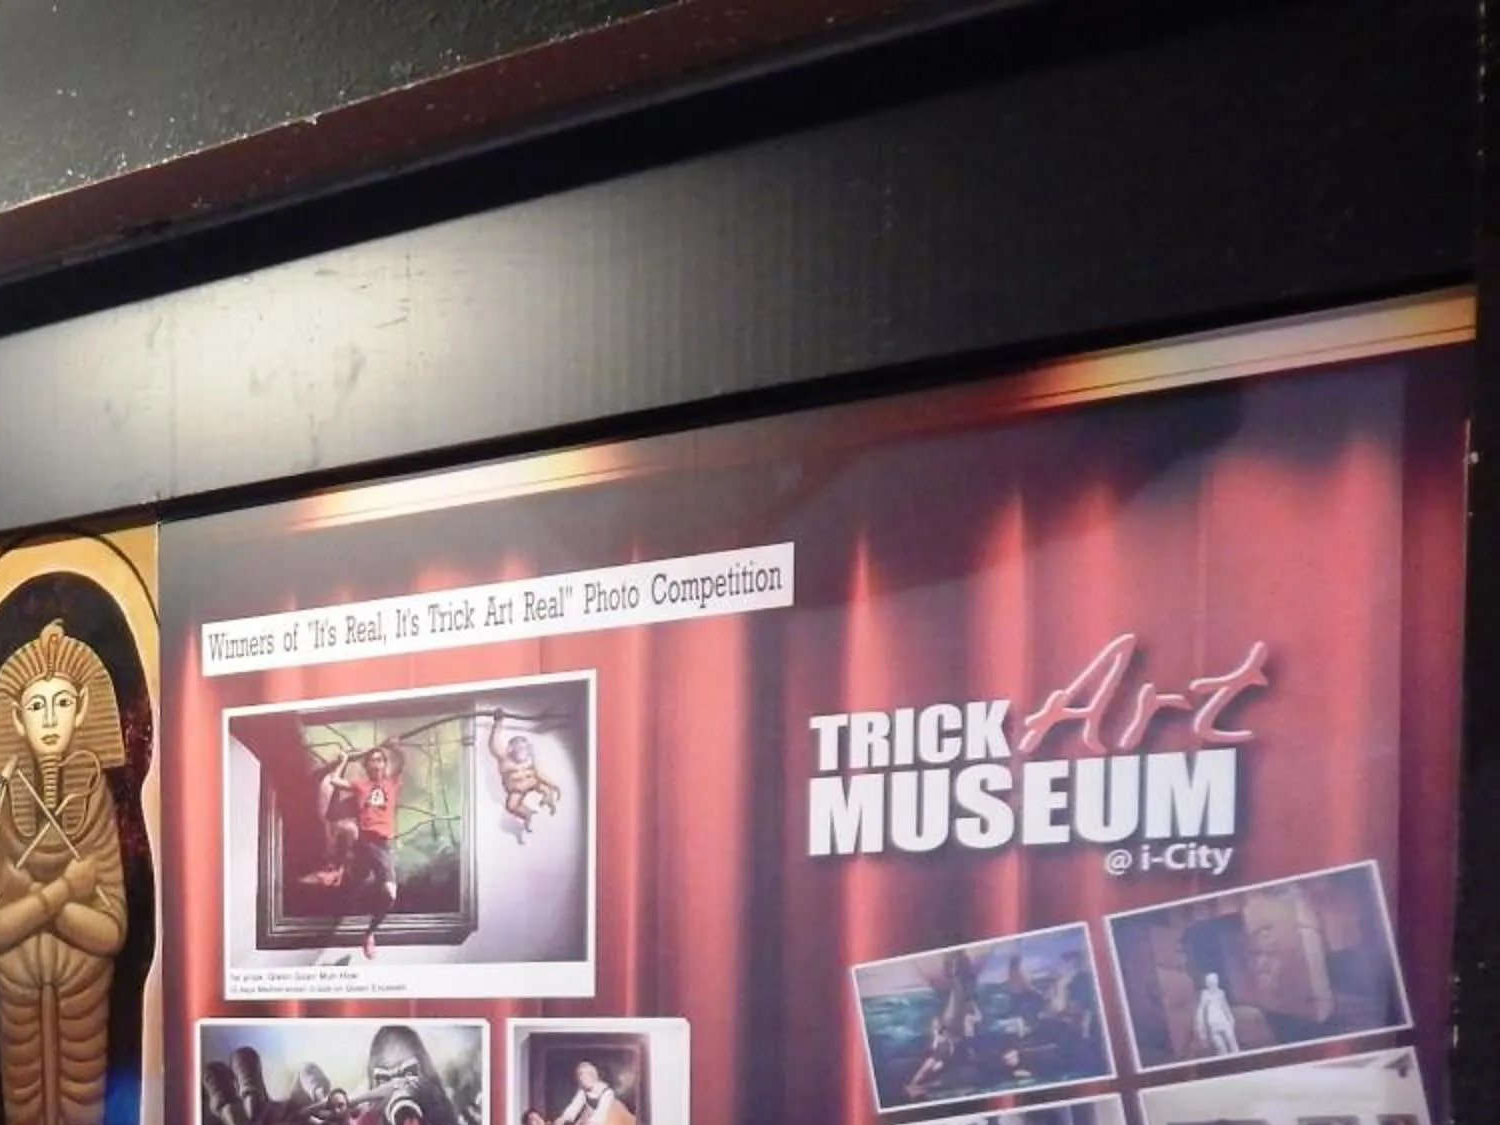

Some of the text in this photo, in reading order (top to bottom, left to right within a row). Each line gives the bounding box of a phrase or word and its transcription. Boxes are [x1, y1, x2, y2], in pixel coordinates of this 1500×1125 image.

[208, 561, 782, 661] Winners of "It's Real, It's Trick Art Real" Photo Competition
[809, 633, 1269, 771] TRICK Art
[807, 748, 1238, 856] MUSEUM
[1104, 842, 1234, 876] @ i-City
